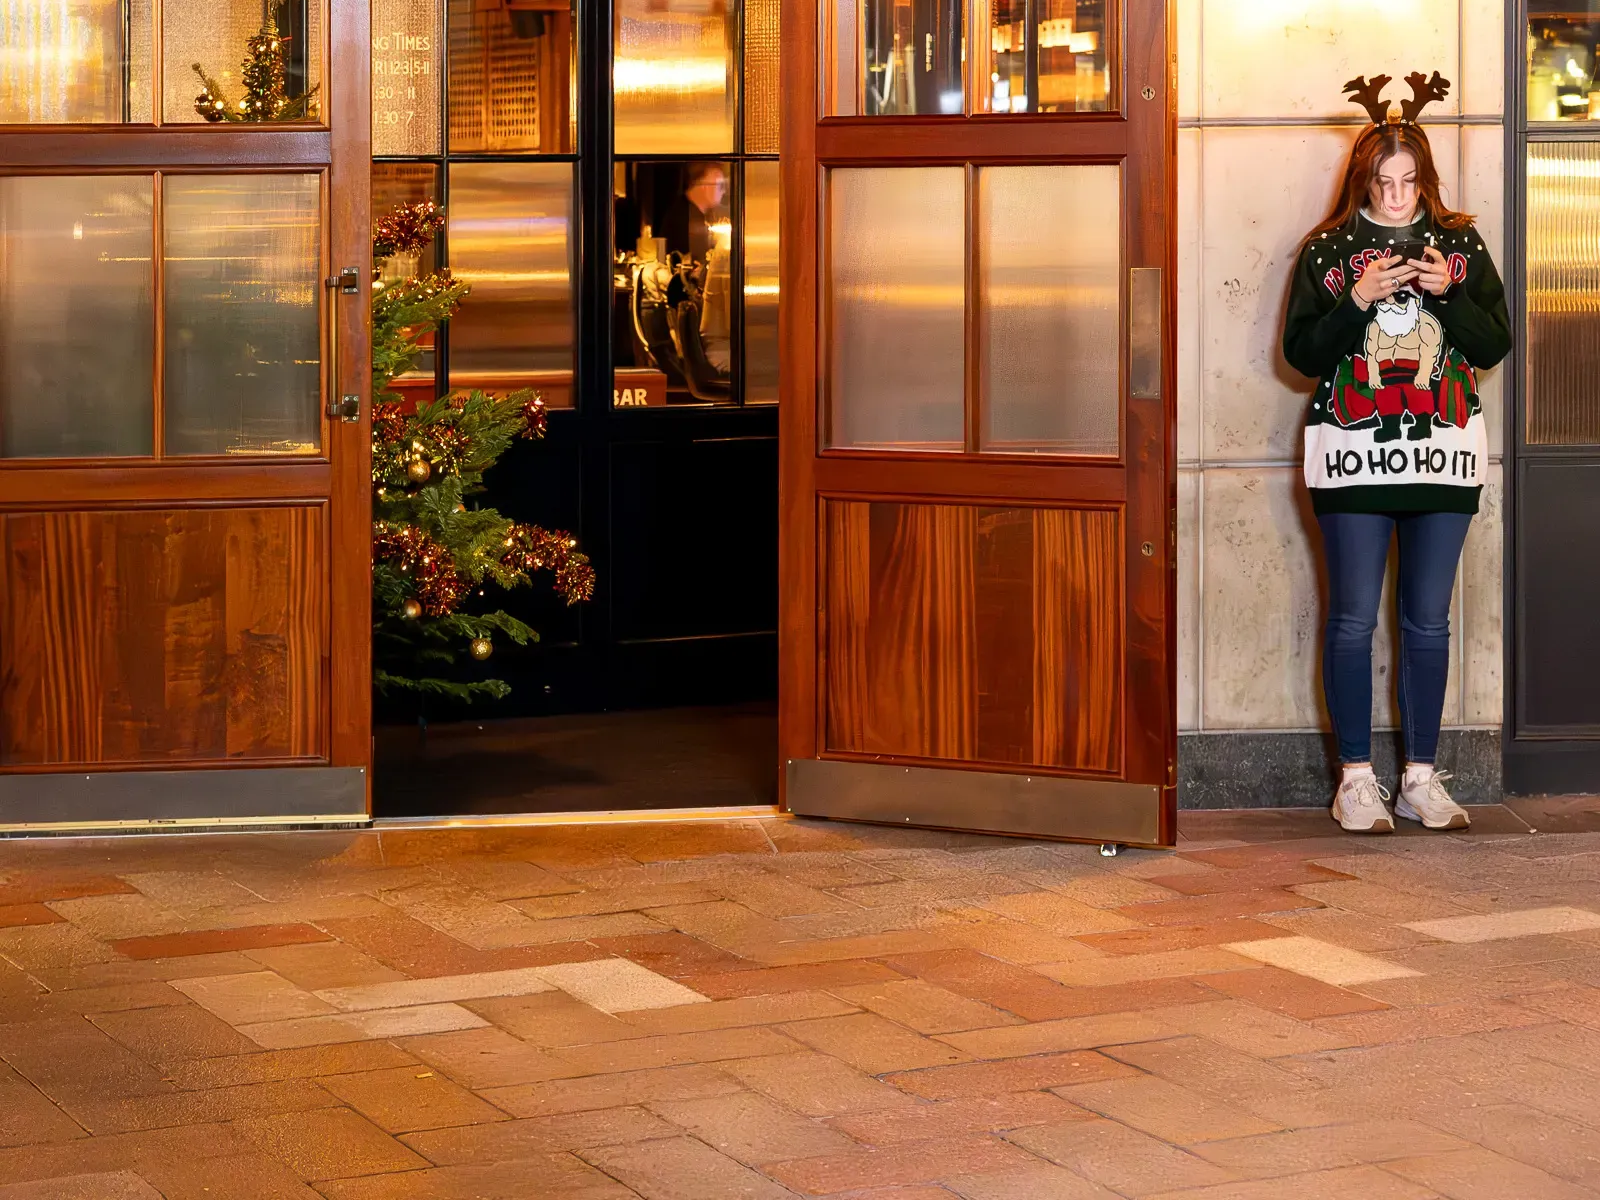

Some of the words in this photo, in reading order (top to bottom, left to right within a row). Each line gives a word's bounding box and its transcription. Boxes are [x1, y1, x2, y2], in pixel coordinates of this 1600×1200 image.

[372, 60, 388, 75] RI
[1325, 449, 1363, 479] HO
[1367, 447, 1408, 475] HO
[1413, 446, 1447, 474] HO
[1452, 450, 1477, 479] IT!
